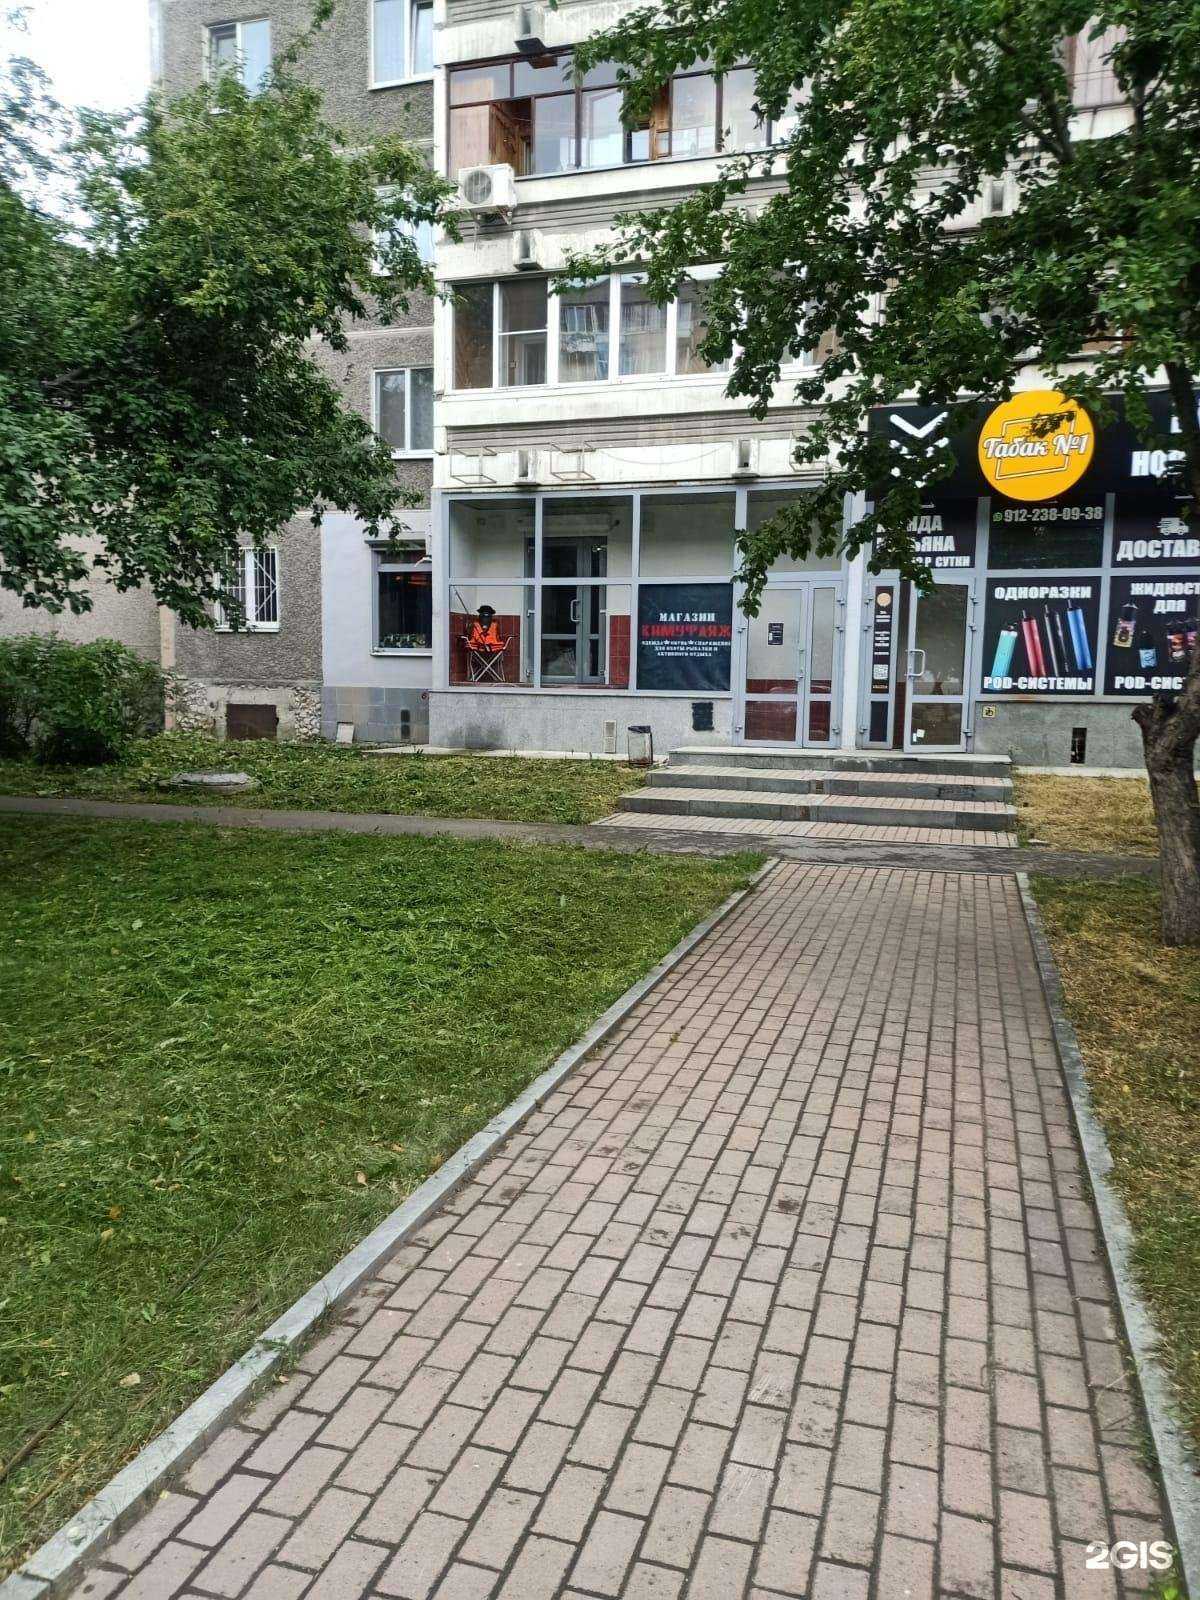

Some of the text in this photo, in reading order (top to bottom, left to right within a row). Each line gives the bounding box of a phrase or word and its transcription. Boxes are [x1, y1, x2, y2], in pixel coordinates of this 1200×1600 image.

[983, 433, 1089, 459] Табак №1
[1004, 506, 1104, 522] 912-238-09-38
[935, 555, 971, 567] СУТКИ
[994, 586, 1092, 600] ОДНОРАЗКИ
[1153, 599, 1187, 614] ДЛЯ
[659, 612, 716, 622] МАГАЗИН
